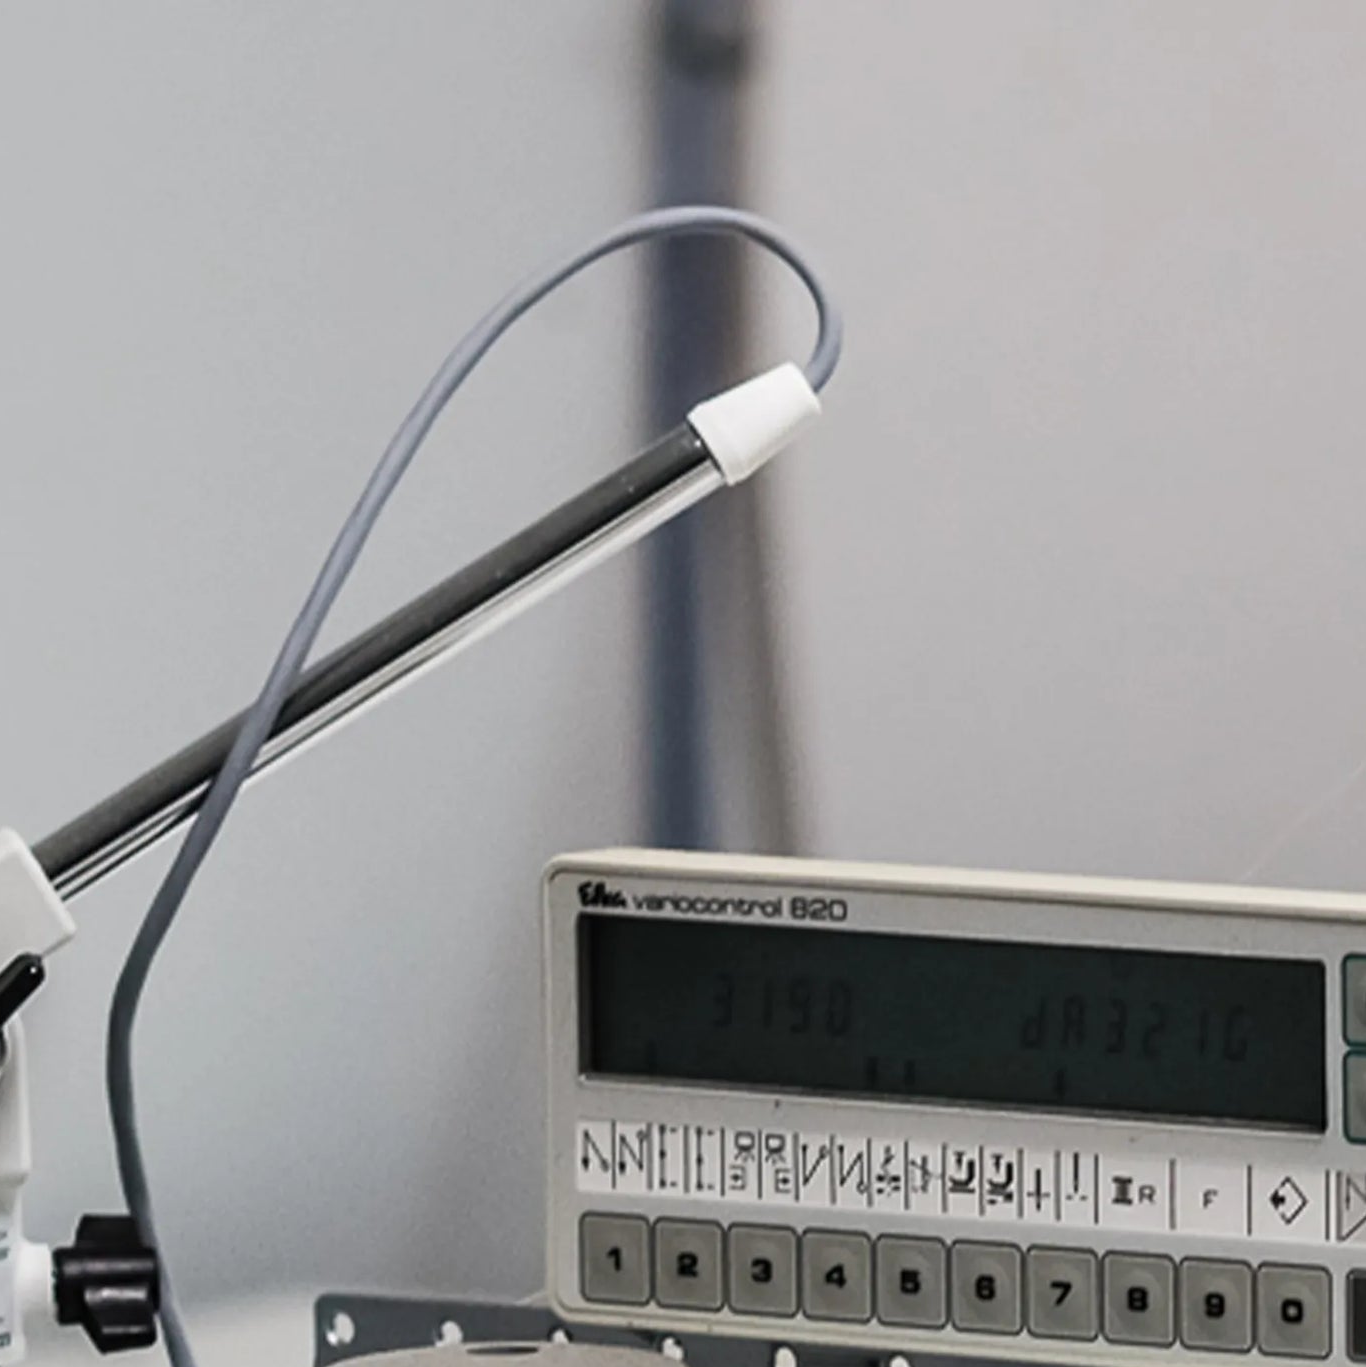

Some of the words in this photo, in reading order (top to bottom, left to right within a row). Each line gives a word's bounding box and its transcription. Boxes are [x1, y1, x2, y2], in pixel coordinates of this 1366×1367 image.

[632, 893, 783, 918] variocontrol
[789, 896, 848, 922] 820
[1139, 1184, 1157, 1202] R
[1202, 1189, 1219, 1207] F
[607, 1247, 622, 1272] 1
[677, 1253, 699, 1276] 2
[751, 1259, 773, 1283] 3
[825, 1264, 846, 1288] 4
[899, 1271, 922, 1295] 5
[975, 1275, 996, 1300] 6
[1050, 1281, 1073, 1306] 7
[1127, 1287, 1149, 1312] 8
[1204, 1293, 1226, 1319] 9
[1281, 1299, 1304, 1324] 0
